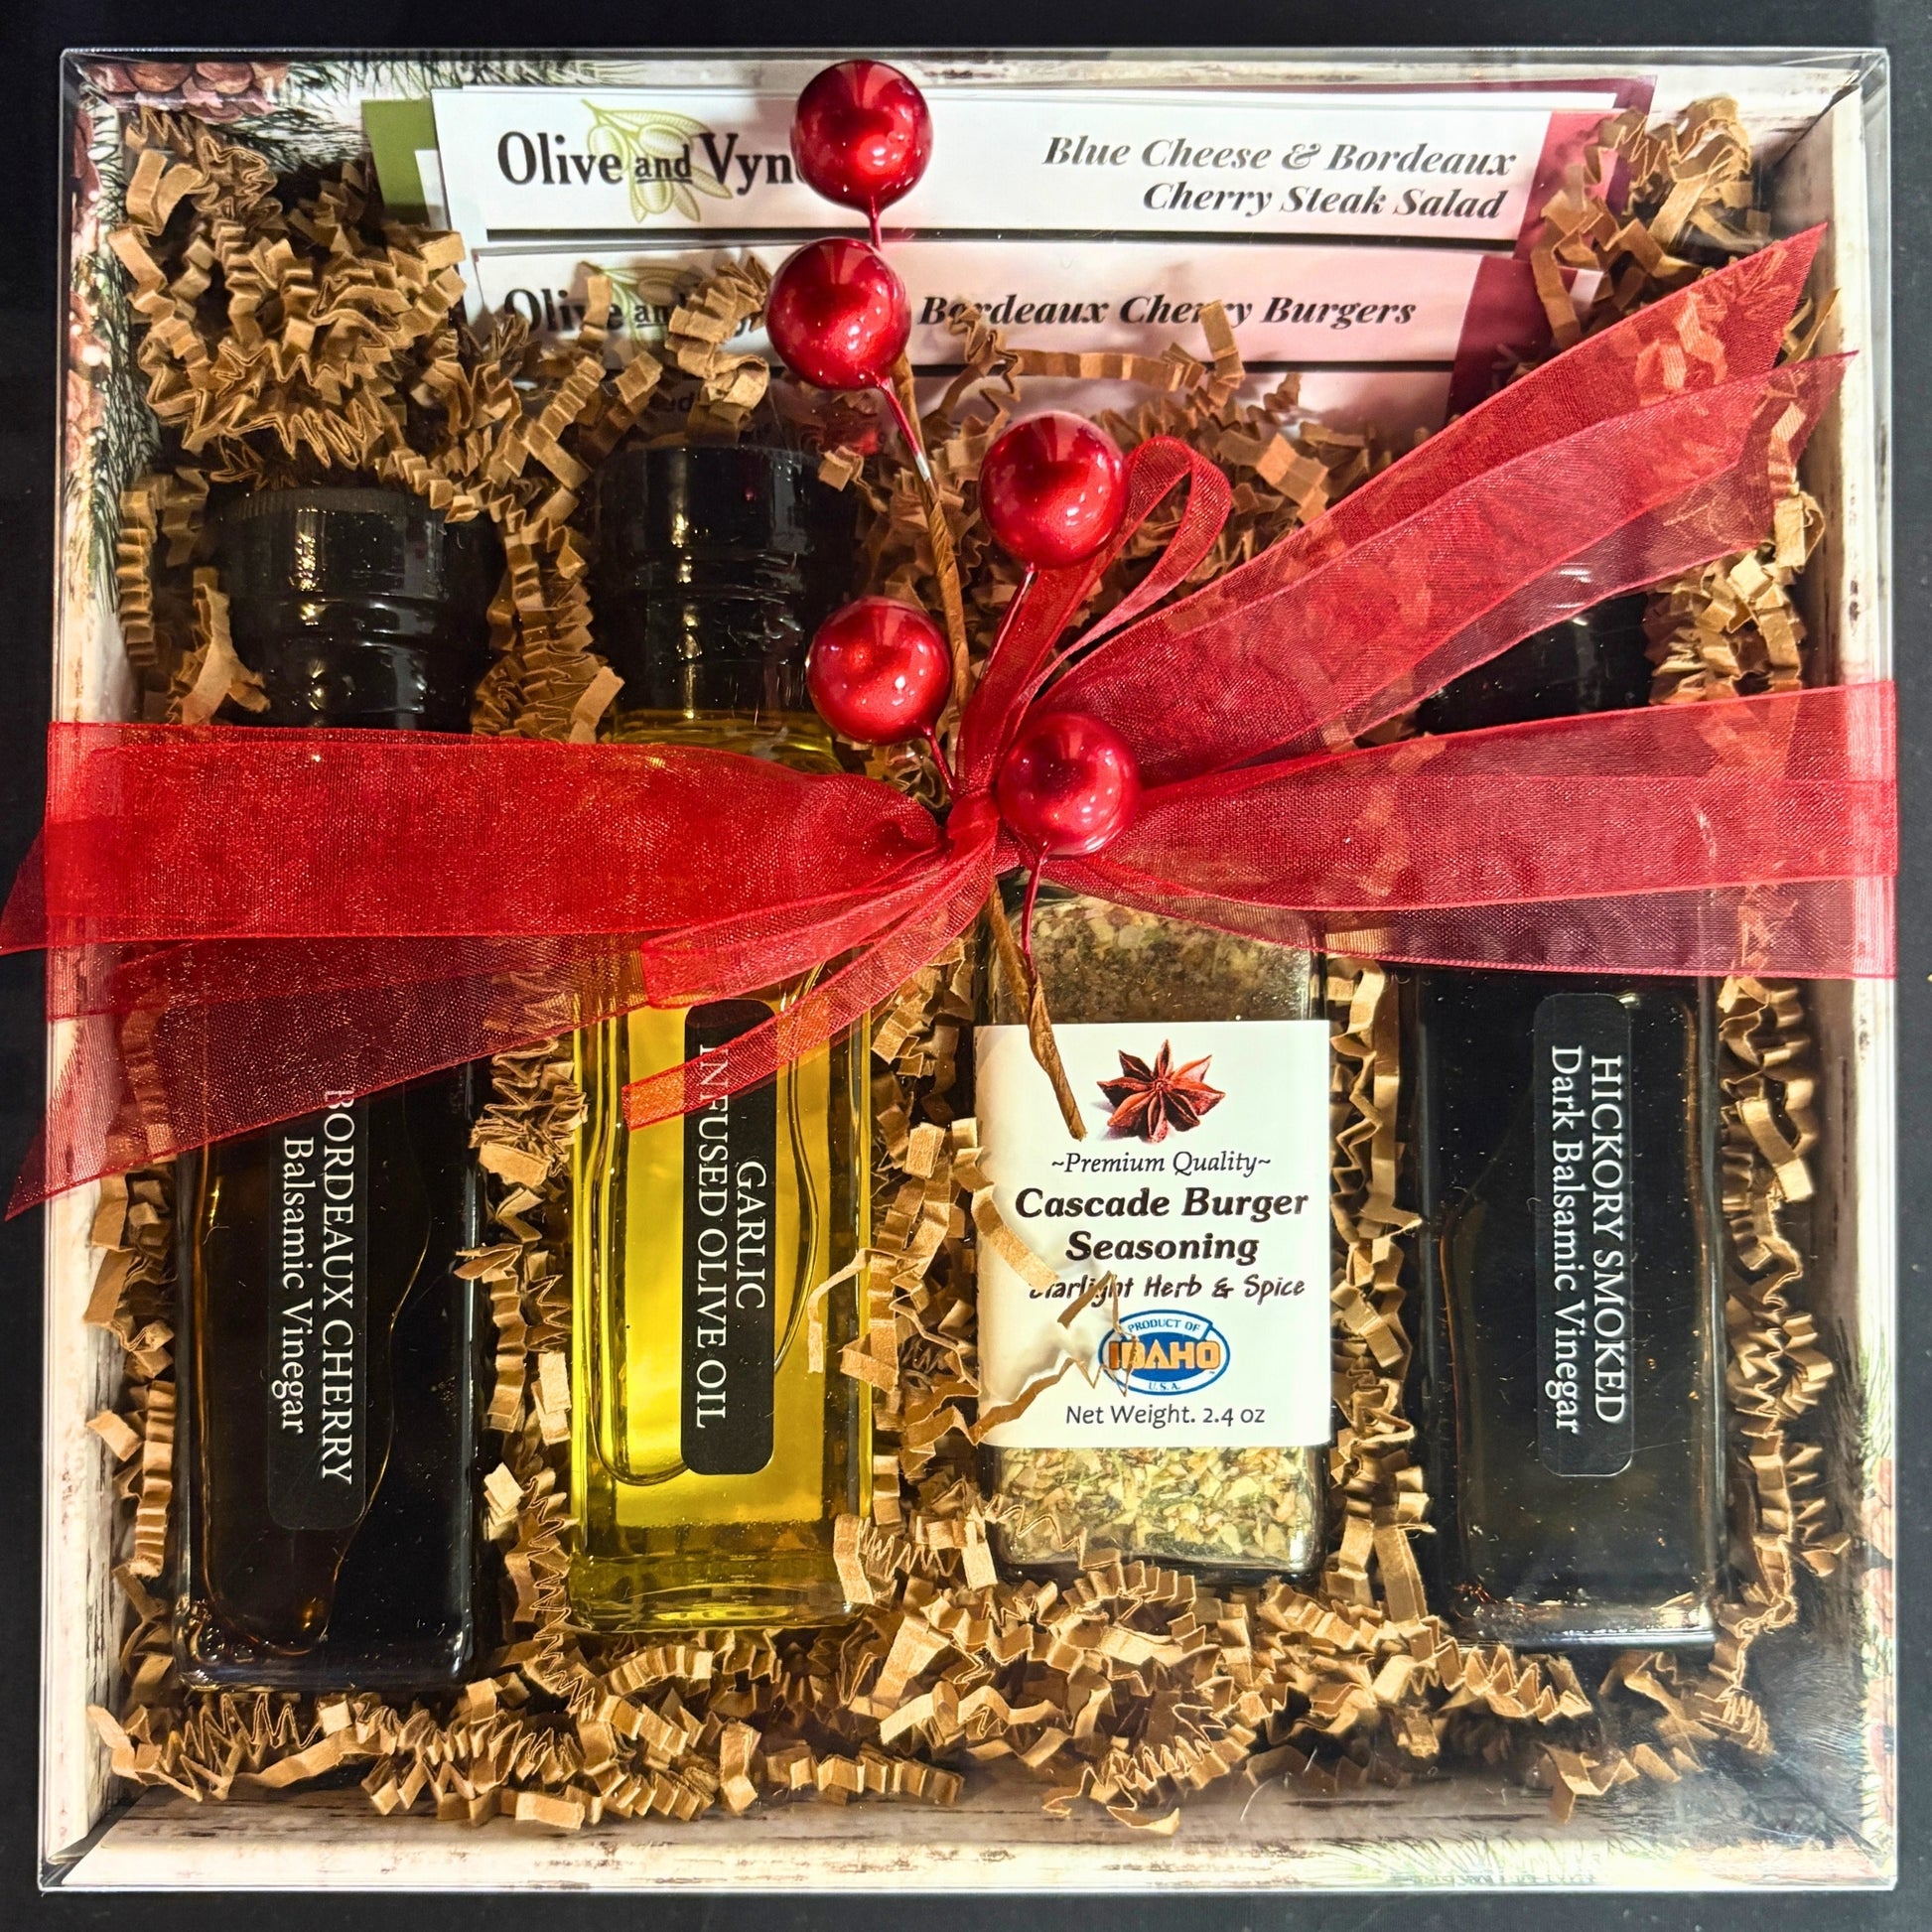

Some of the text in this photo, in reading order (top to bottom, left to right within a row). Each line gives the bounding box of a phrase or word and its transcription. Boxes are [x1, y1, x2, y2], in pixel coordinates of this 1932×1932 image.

[497, 131, 806, 196] Olive and Vyn
[1042, 135, 1517, 176] Blue Cheese & Bordeaux
[1143, 181, 1509, 218] Cherry Steak Salad
[1263, 296, 1417, 329] Burgers
[1014, 1186, 1310, 1223] Cascade Burger
[695, 1043, 730, 1429] INFUSED OLIVE OIL
[735, 1161, 767, 1310] GARLIC
[1064, 1230, 1261, 1267] Seasoning
[1544, 1044, 1587, 1435] Dark Balsamic Vinegar
[1590, 1054, 1627, 1425] HICKORY SMOKED
[271, 1136, 315, 1434] Balsamic Vinegar
[321, 1089, 355, 1485] BORDEAUX CHERRY
[1143, 1274, 1203, 1300] Herb
[1210, 1276, 1235, 1300] &
[1243, 1274, 1306, 1305] Spice
[1127, 1318, 1201, 1333] PRODUCT OF
[1108, 1340, 1221, 1370] IDAHO
[1065, 1403, 1266, 1430] Net Weight. 2.4 oz
